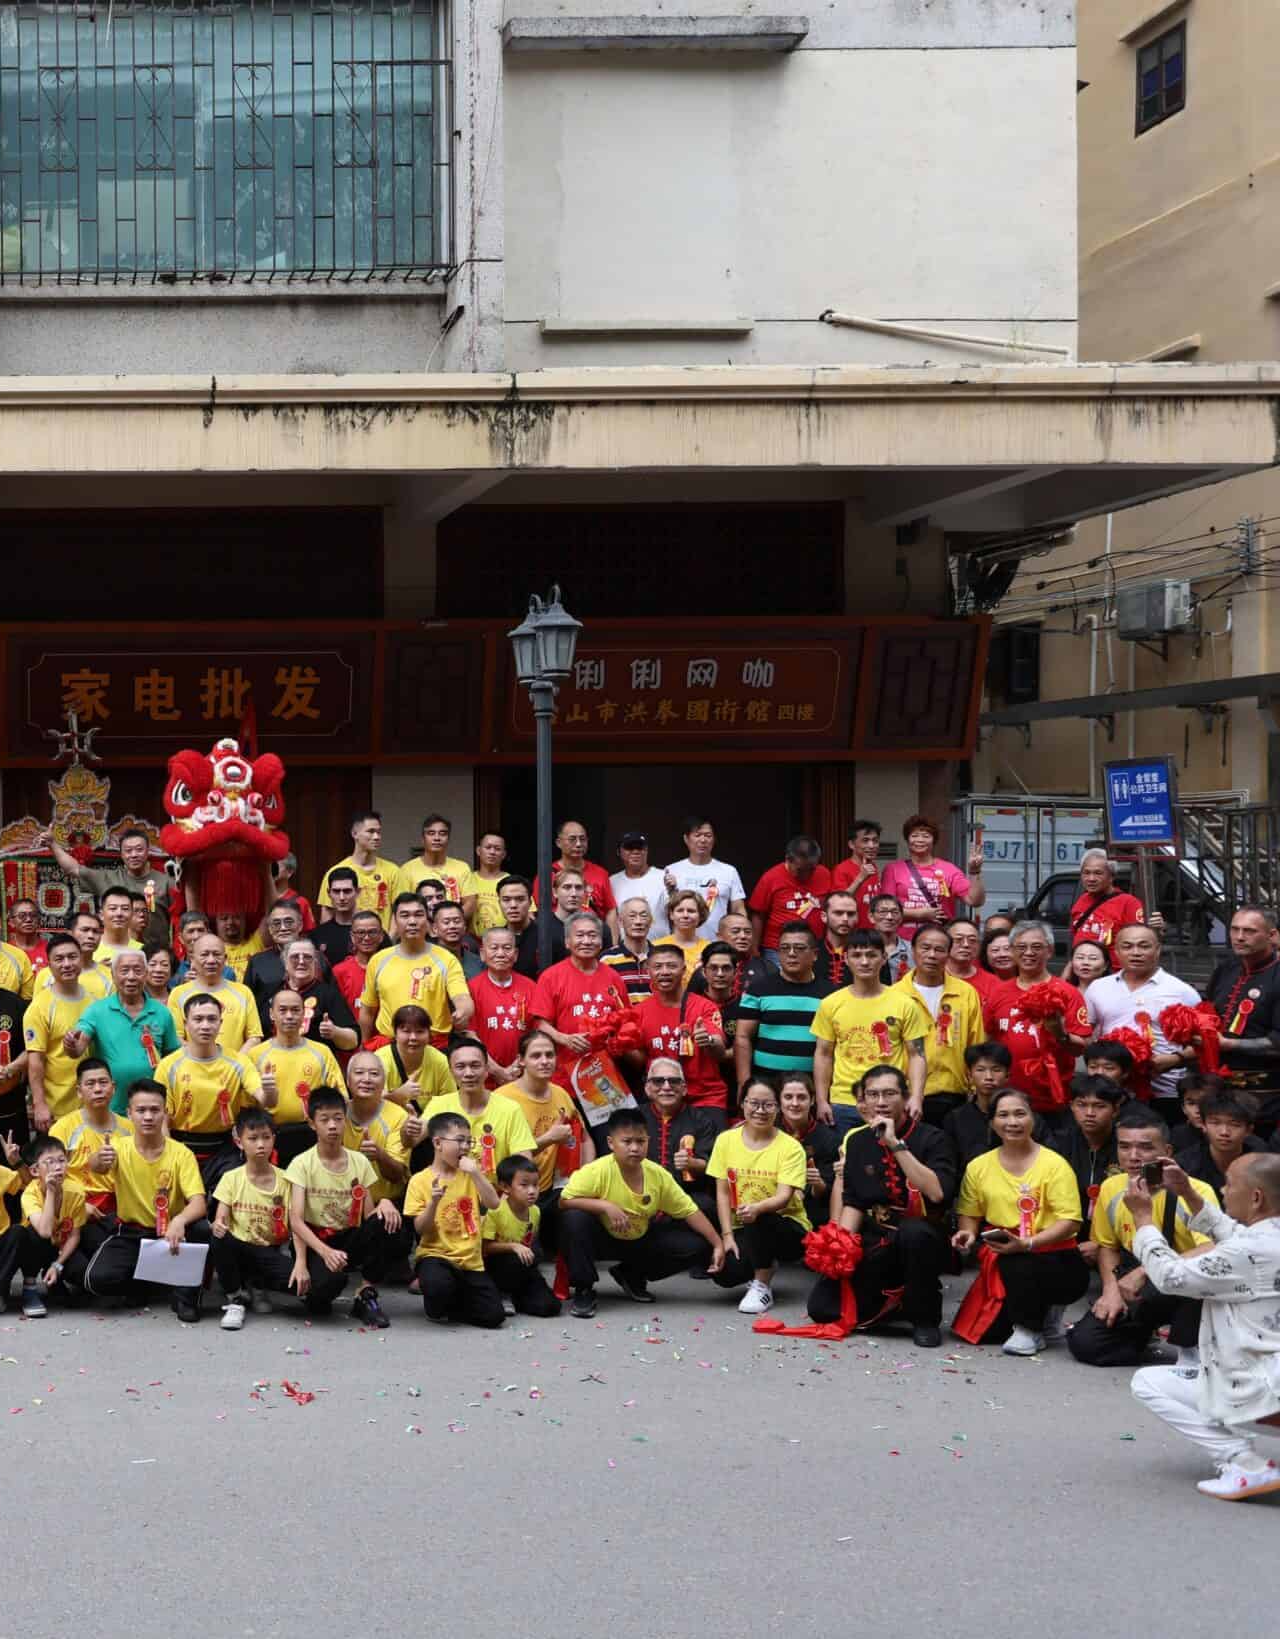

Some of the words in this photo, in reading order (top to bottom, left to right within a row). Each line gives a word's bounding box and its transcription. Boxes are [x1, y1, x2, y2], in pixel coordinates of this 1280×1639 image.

[60, 666, 321, 721] 家电批发
[546, 699, 772, 725] 山市洪拳國術館
[983, 840, 1083, 861] 粤J716T
